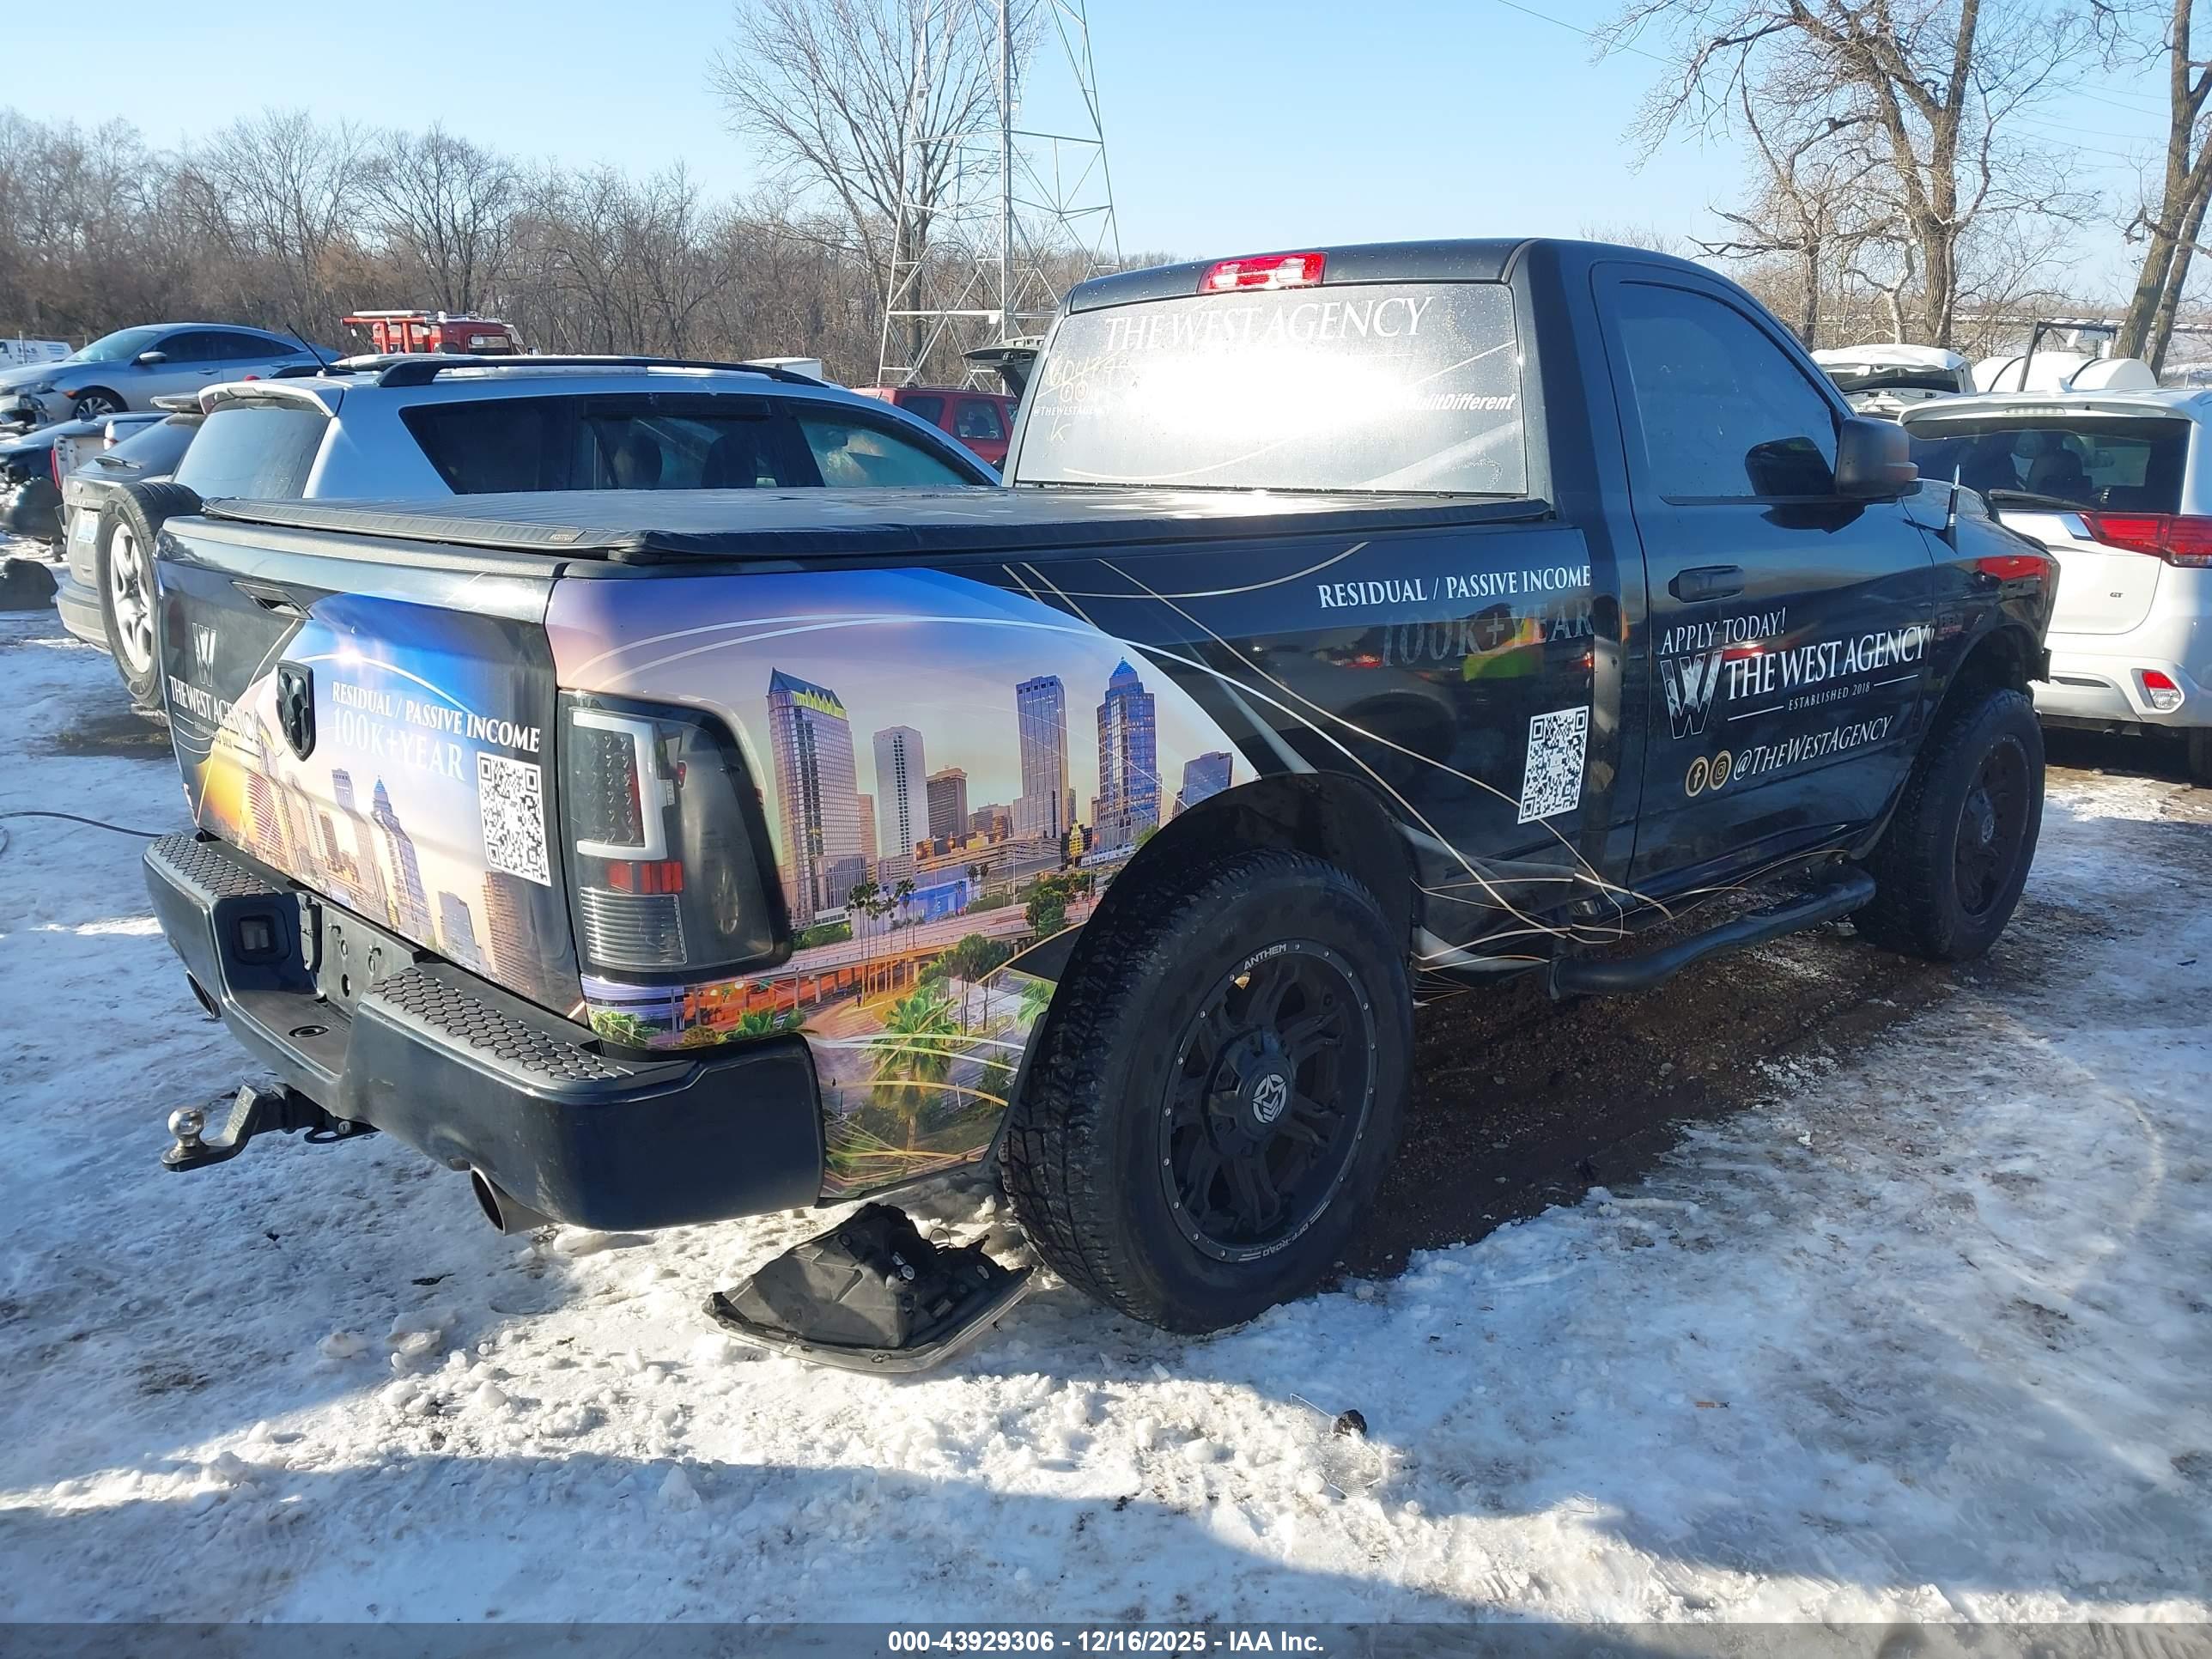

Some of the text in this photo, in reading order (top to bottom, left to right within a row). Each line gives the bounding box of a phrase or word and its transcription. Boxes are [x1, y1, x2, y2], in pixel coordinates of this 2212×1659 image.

[1105, 295, 1435, 353] THE WEST AGENCY
[1317, 565, 1591, 609] RESIDUAL / PASSIVE INCOME
[1382, 598, 1595, 667] 100K+YEAR
[1660, 607, 1787, 655] APPLY TODAY!
[1725, 654, 1777, 702] THE
[1780, 638, 1844, 686] WEST
[1845, 623, 1932, 675] AGENCY
[168, 675, 188, 709] THE
[185, 684, 212, 721] WEST
[332, 681, 394, 719] RESIDUAL
[405, 700, 465, 734] PASSIVE
[467, 713, 541, 753] INCOME
[1788, 680, 1871, 711] ESTABLISHED 2018
[332, 707, 466, 782] 100K+YEAR
[1243, 943, 1287, 971] ANTHEM
[1262, 1222, 1310, 1257] OFF-ROAD
